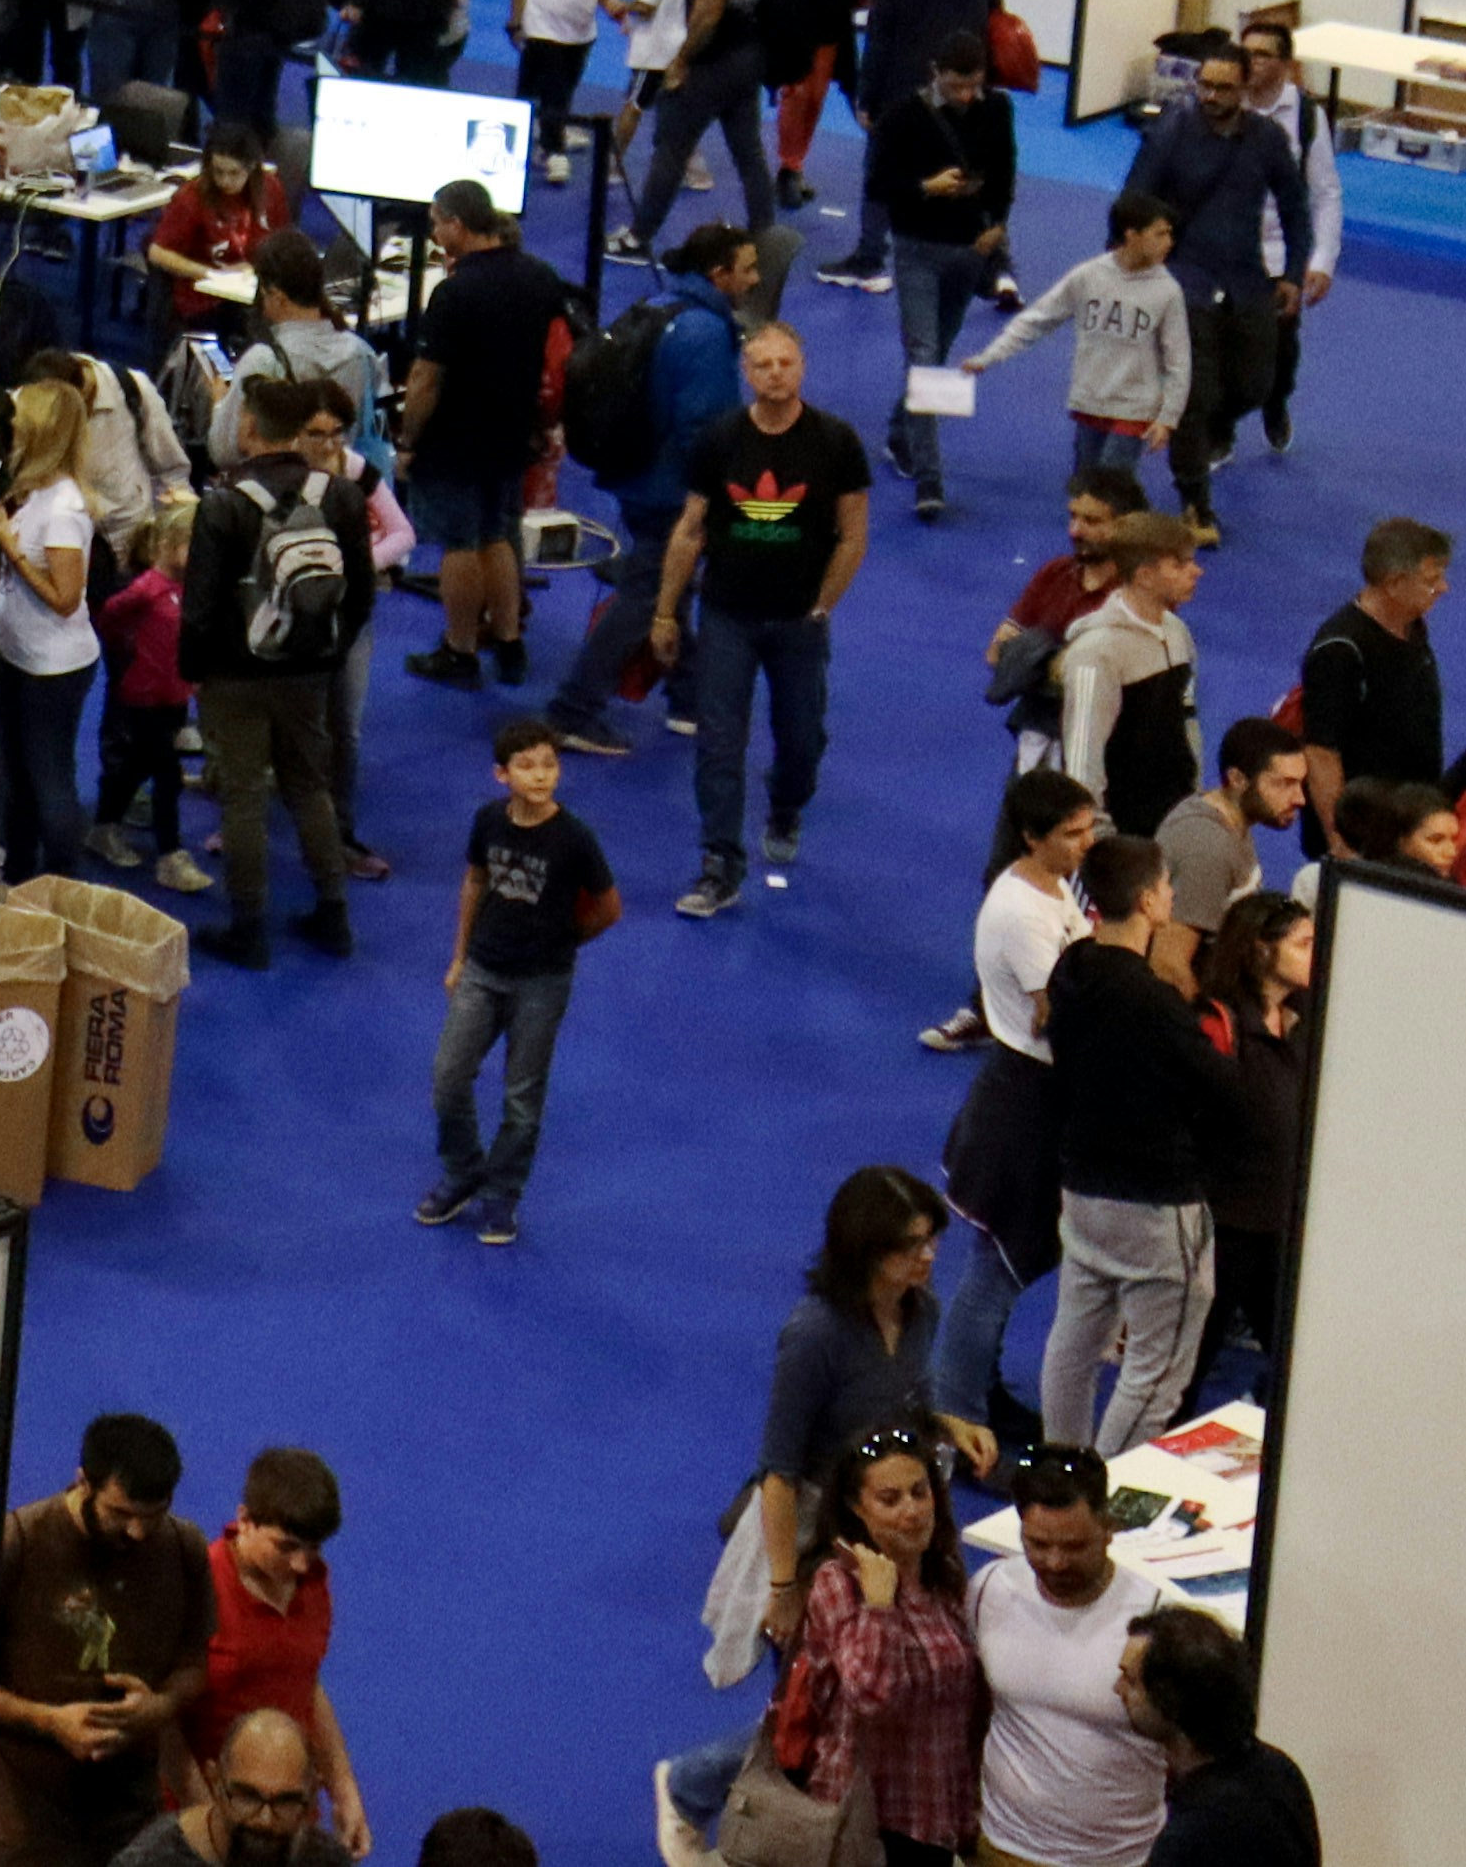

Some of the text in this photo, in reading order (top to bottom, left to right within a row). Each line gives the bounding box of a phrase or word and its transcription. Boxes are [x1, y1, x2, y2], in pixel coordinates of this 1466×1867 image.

[1083, 298, 1150, 340] GAP
[84, 994, 109, 1082] FIERA
[103, 987, 129, 1086] ROMA
